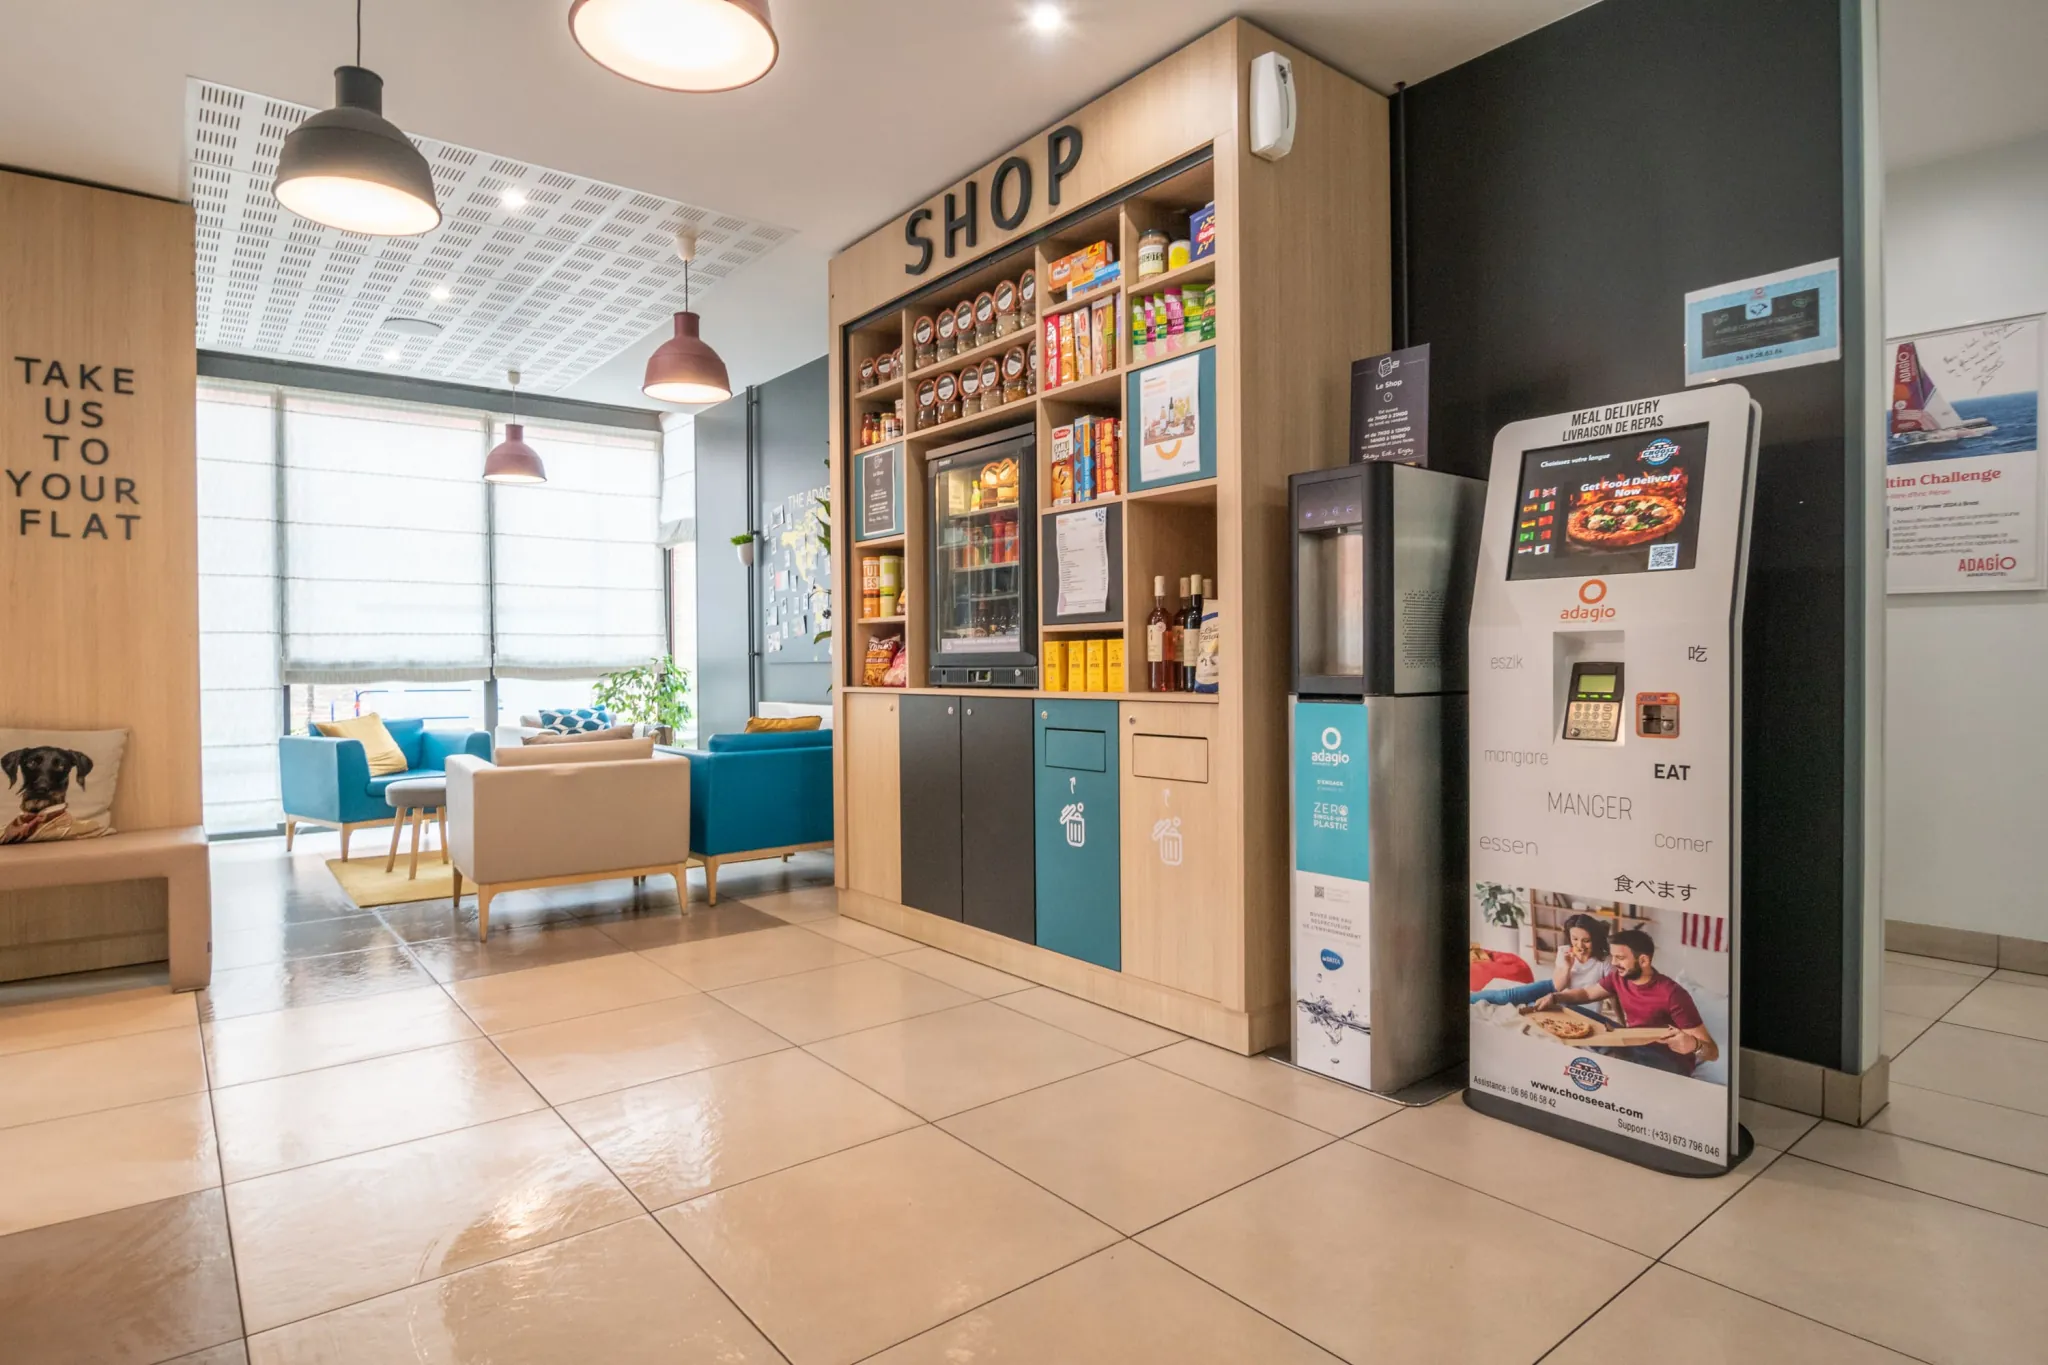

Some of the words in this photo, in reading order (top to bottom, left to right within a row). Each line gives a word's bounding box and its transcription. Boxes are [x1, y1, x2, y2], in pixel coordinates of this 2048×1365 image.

[905, 125, 1083, 275] SHOP
[14, 356, 135, 395] TAKE
[1385, 379, 1403, 389] Shop
[45, 397, 104, 428] US
[1571, 410, 1600, 426] MEAL
[1605, 399, 1660, 421] DELIVERY
[1562, 422, 1612, 442] LIVRAISON
[1615, 421, 1628, 434] DE
[1631, 414, 1664, 432] REPAS
[43, 434, 109, 465] TO
[5, 469, 140, 505] YOUR
[1580, 483, 1600, 491] Get
[1602, 478, 1630, 489] Food
[1632, 474, 1681, 485] Delivery
[1920, 469, 2001, 486] Challenge
[1615, 488, 1642, 497] Now
[19, 508, 142, 540] FLAT
[1560, 604, 1616, 622] adagio
[1491, 652, 1524, 669] eszik
[1688, 644, 1707, 662] 吃
[1311, 749, 1350, 767] adagio
[1484, 749, 1549, 767] mangiare
[1654, 763, 1691, 781] EAT
[1548, 791, 1632, 820] MANGER
[1313, 819, 1348, 830] PLASTIC
[1479, 835, 1539, 856] essen
[1614, 874, 1697, 901] 食べます
[1326, 956, 1340, 965] BRITA
[1569, 1067, 1604, 1081] CHOOSE
[1473, 1075, 1506, 1092] Assistance
[1511, 1086, 1519, 1097] 06
[1520, 1088, 1528, 1099] 86
[1529, 1091, 1538, 1102] 06
[1548, 1097, 1556, 1108] 42
[1530, 1079, 1643, 1119] www.chooseeat.com
[1617, 1118, 1646, 1135] Support
[1651, 1128, 1671, 1145] (+33)
[1672, 1135, 1687, 1148] 673
[1688, 1139, 1703, 1152] 796
[1704, 1144, 1719, 1157] 046
